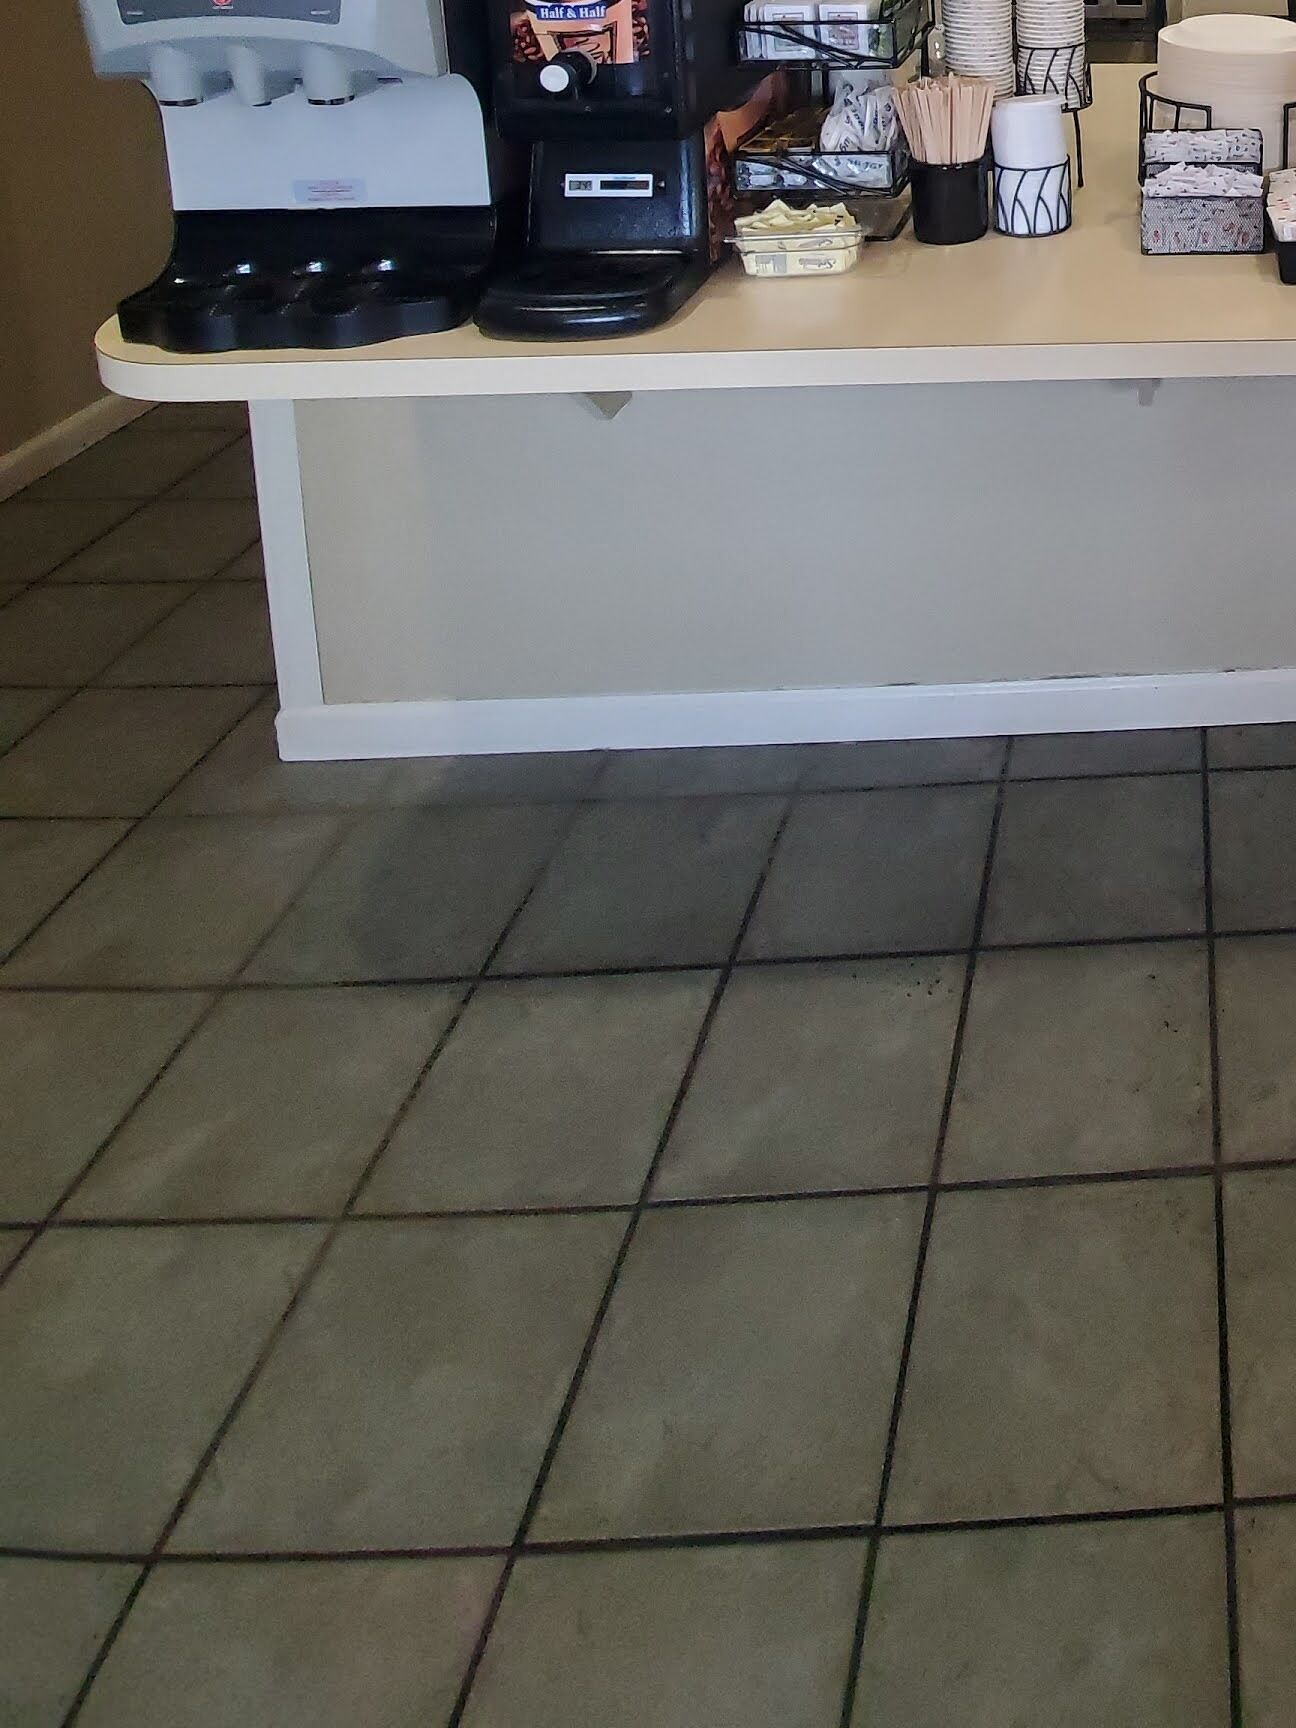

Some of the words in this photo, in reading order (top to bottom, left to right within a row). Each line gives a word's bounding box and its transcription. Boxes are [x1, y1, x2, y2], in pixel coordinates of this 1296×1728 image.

[540, 6, 565, 19] Half
[566, 8, 577, 19] &
[579, 6, 606, 18] Half
